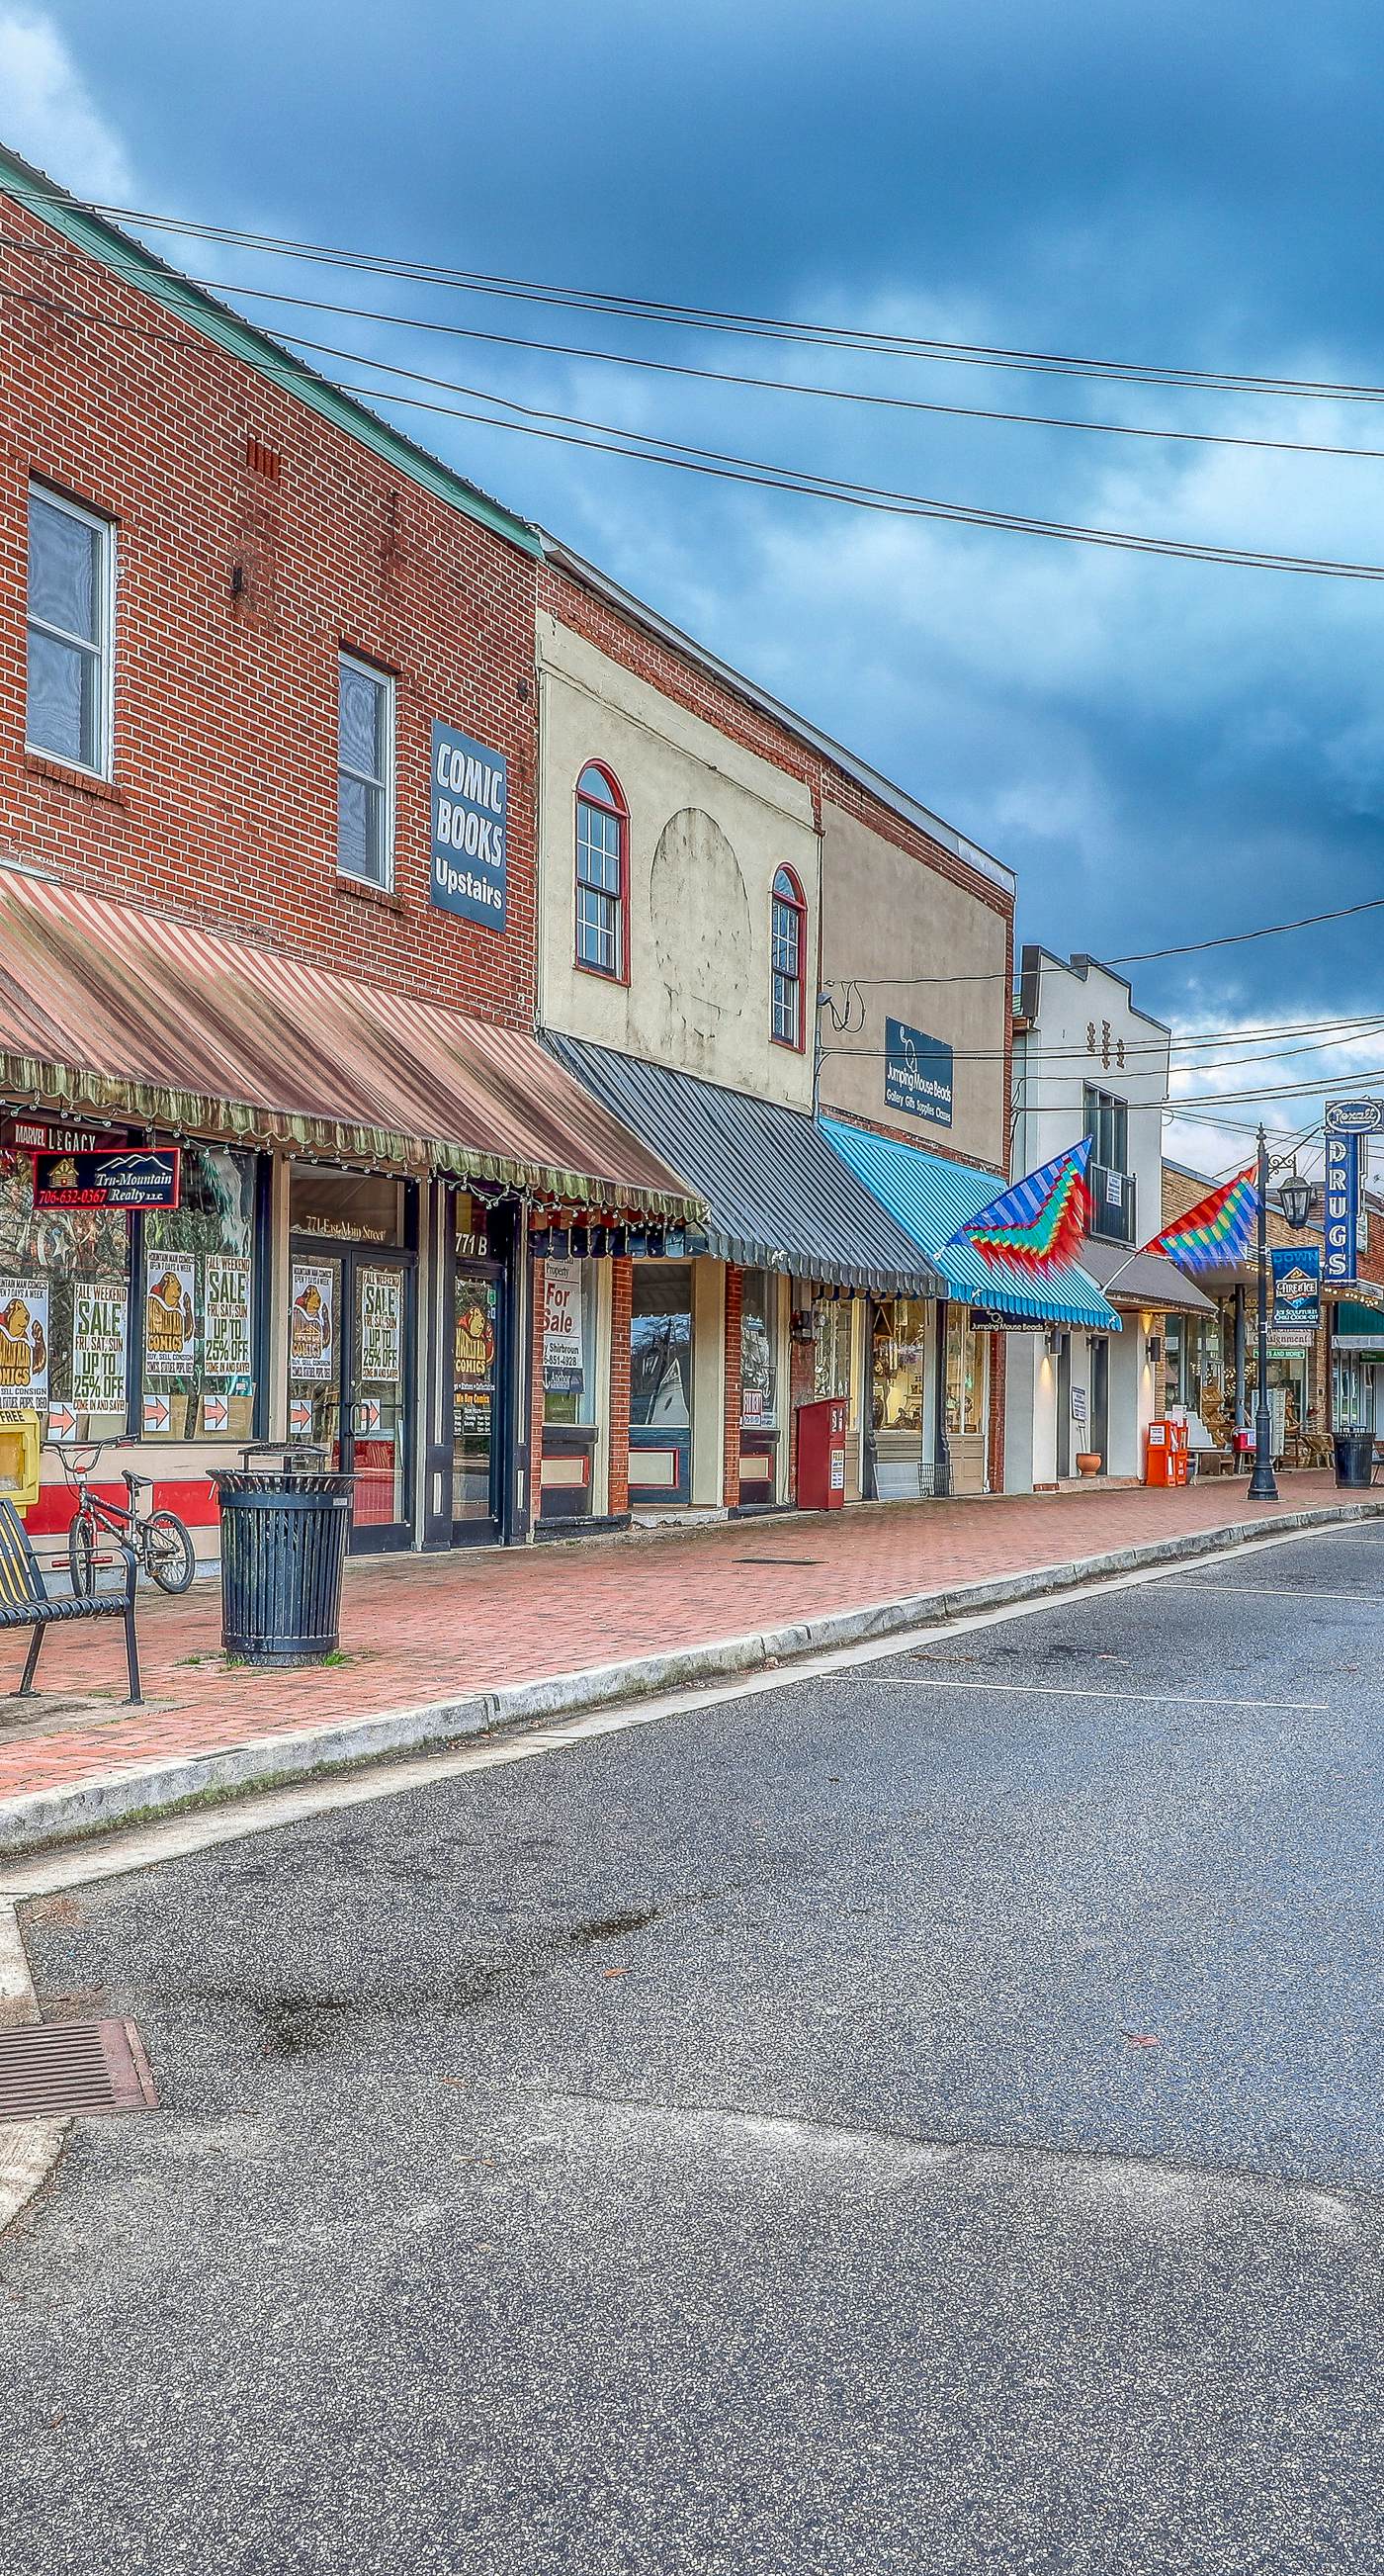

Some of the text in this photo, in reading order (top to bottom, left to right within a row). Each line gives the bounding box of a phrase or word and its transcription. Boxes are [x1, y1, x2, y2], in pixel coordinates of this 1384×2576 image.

[436, 743, 503, 815] COMIC
[436, 797, 503, 868] BOOKS
[435, 856, 502, 911] Upstairs
[887, 1062, 952, 1103] Jumping Mouse Beads
[886, 1088, 904, 1107] Gallery
[1334, 1108, 1377, 1124] Rexall
[15, 1123, 96, 1152] MARVEL LEGACY
[95, 1172, 172, 1187] Tru-Mountain
[39, 1189, 108, 1204] 706-632-0367
[109, 1188, 145, 1203] Realty
[1328, 1140, 1347, 1276] DRUGS
[305, 1215, 320, 1232] 771
[455, 1232, 487, 1256] 771 B
[207, 1256, 250, 1273] FALL WEEKEND
[1273, 1250, 1318, 1263] DOWN
[546, 1263, 570, 1280] Property
[76, 1284, 127, 1302] FALL WEEKEND
[210, 1272, 245, 1303] SALE
[546, 1283, 570, 1307] For
[366, 1286, 395, 1317] SALE
[78, 1300, 122, 1336] SALE
[545, 1307, 572, 1334] Sale
[972, 1322, 999, 1331] Jumping
[214, 1318, 241, 1340] UP TO
[369, 1328, 391, 1349] UP TO
[109, 1339, 124, 1353] SUN
[148, 1334, 183, 1353] COMICS
[1254, 1334, 1308, 1345] Csignment
[206, 1340, 248, 1362] 25% OFF
[364, 1348, 397, 1368] 25% OFF
[82, 1353, 116, 1376] UP TO
[456, 1359, 485, 1375] COMICS
[74, 1376, 125, 1399] 25% OFF
[474, 1393, 490, 1404] Comics
[0, 1410, 25, 1423] FREE
